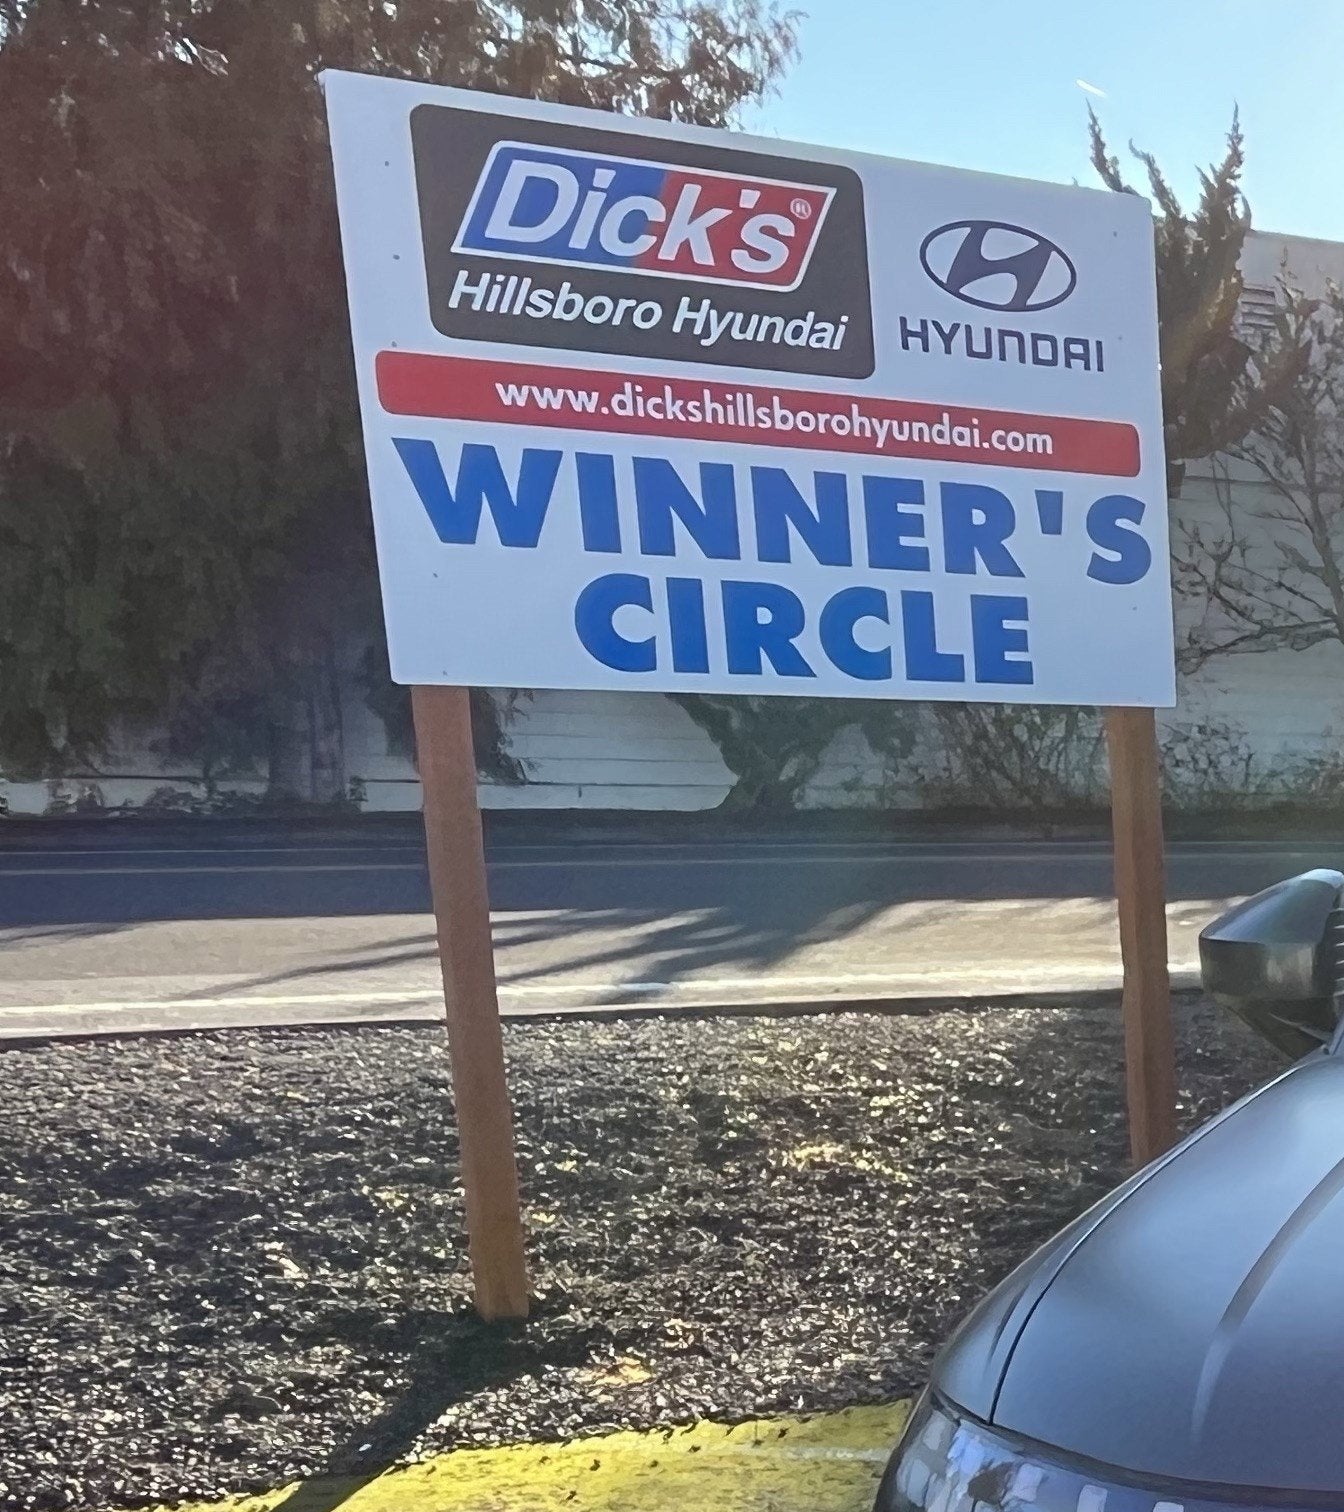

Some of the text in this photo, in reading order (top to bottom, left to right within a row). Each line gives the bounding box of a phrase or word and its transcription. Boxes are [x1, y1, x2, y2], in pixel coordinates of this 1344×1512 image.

[485, 160, 795, 274] Dick's
[448, 268, 849, 351] Hillsboro Hyundai
[899, 315, 1105, 373] HYUNDAI
[495, 381, 1054, 456] www.dickshillsborohyundai.com
[391, 437, 1153, 585] WINNER'S
[574, 572, 1034, 685] CIRCLE
